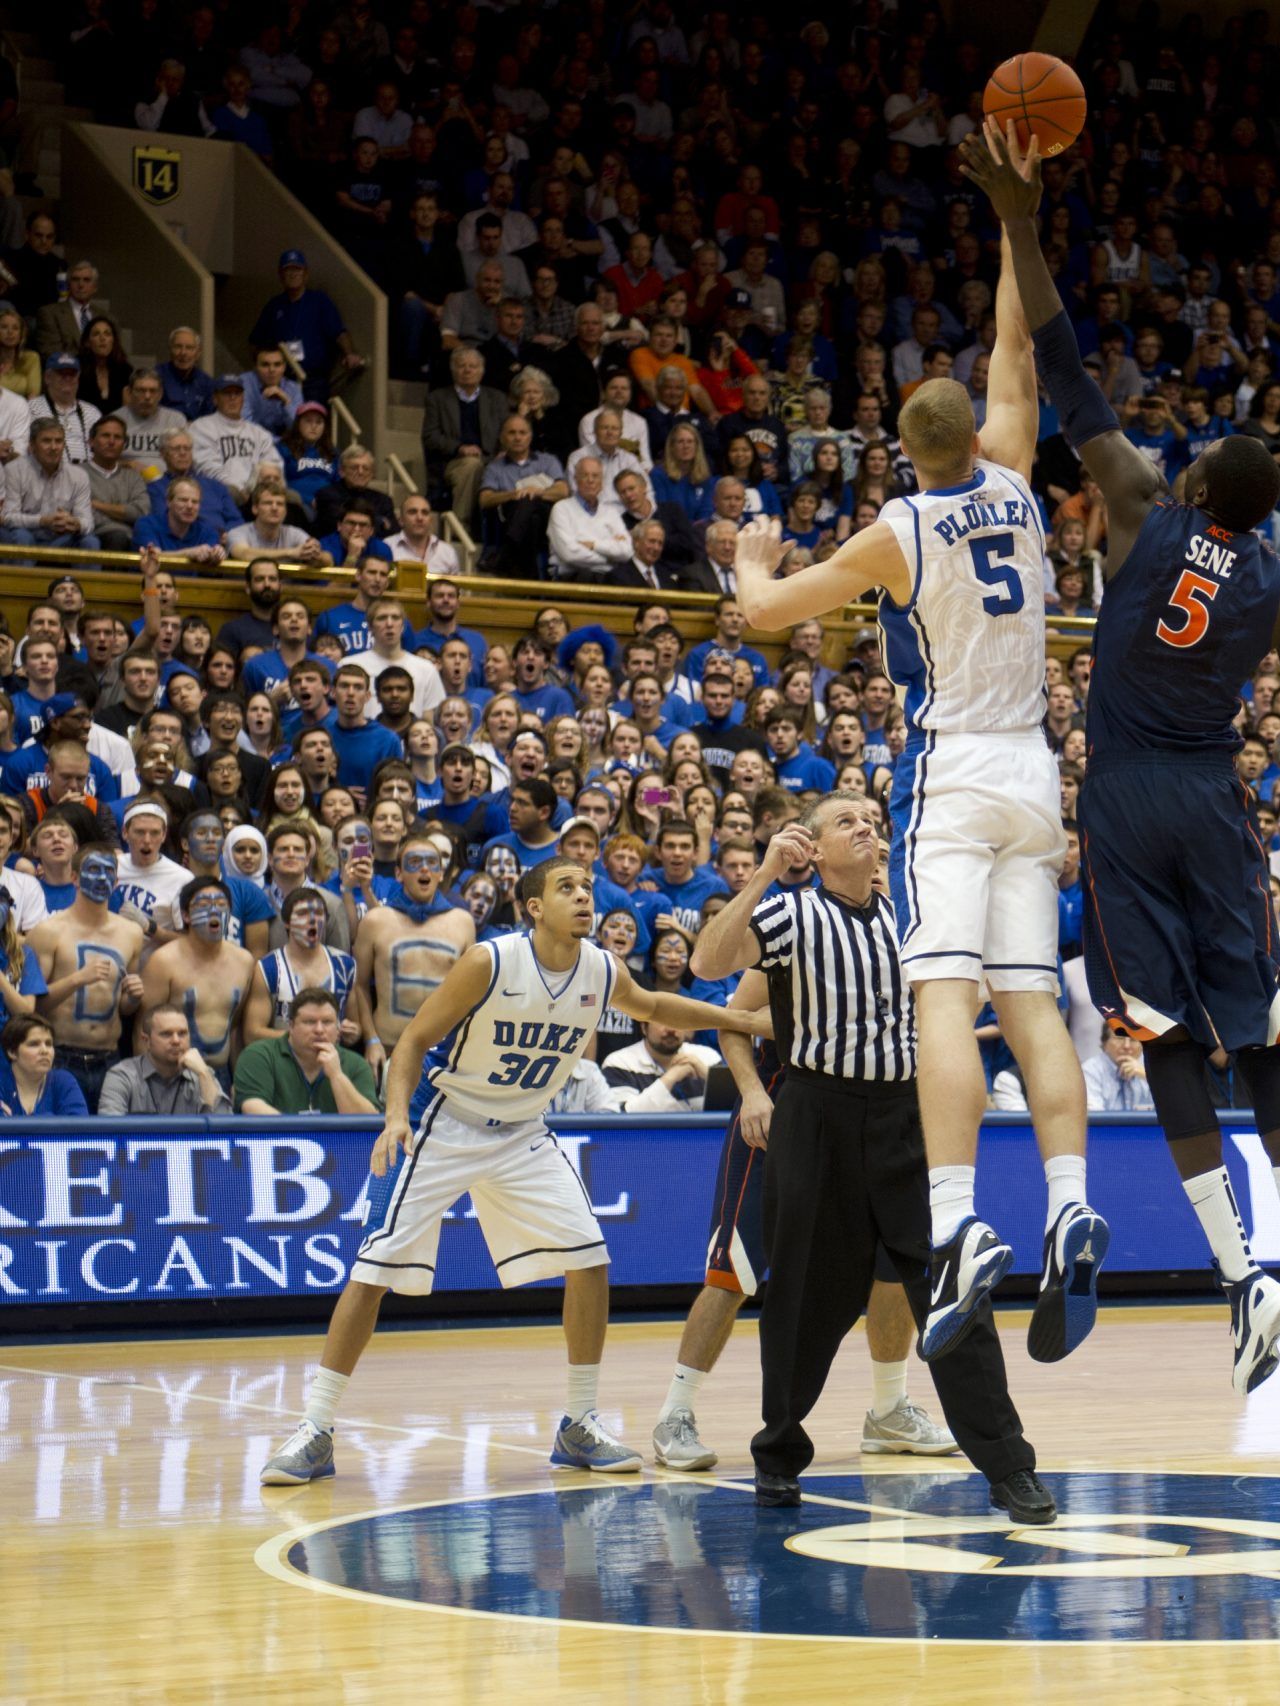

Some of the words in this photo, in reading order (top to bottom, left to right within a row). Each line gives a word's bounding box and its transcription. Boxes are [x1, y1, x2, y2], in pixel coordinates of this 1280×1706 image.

[143, 161, 174, 193] 14
[123, 434, 162, 453] UK
[1184, 534, 1238, 578] SENE
[968, 532, 1025, 617] 5
[1155, 568, 1220, 648] 5
[339, 631, 376, 652] DUK
[493, 1020, 587, 1055] DUKE
[487, 1053, 561, 1090] 30
